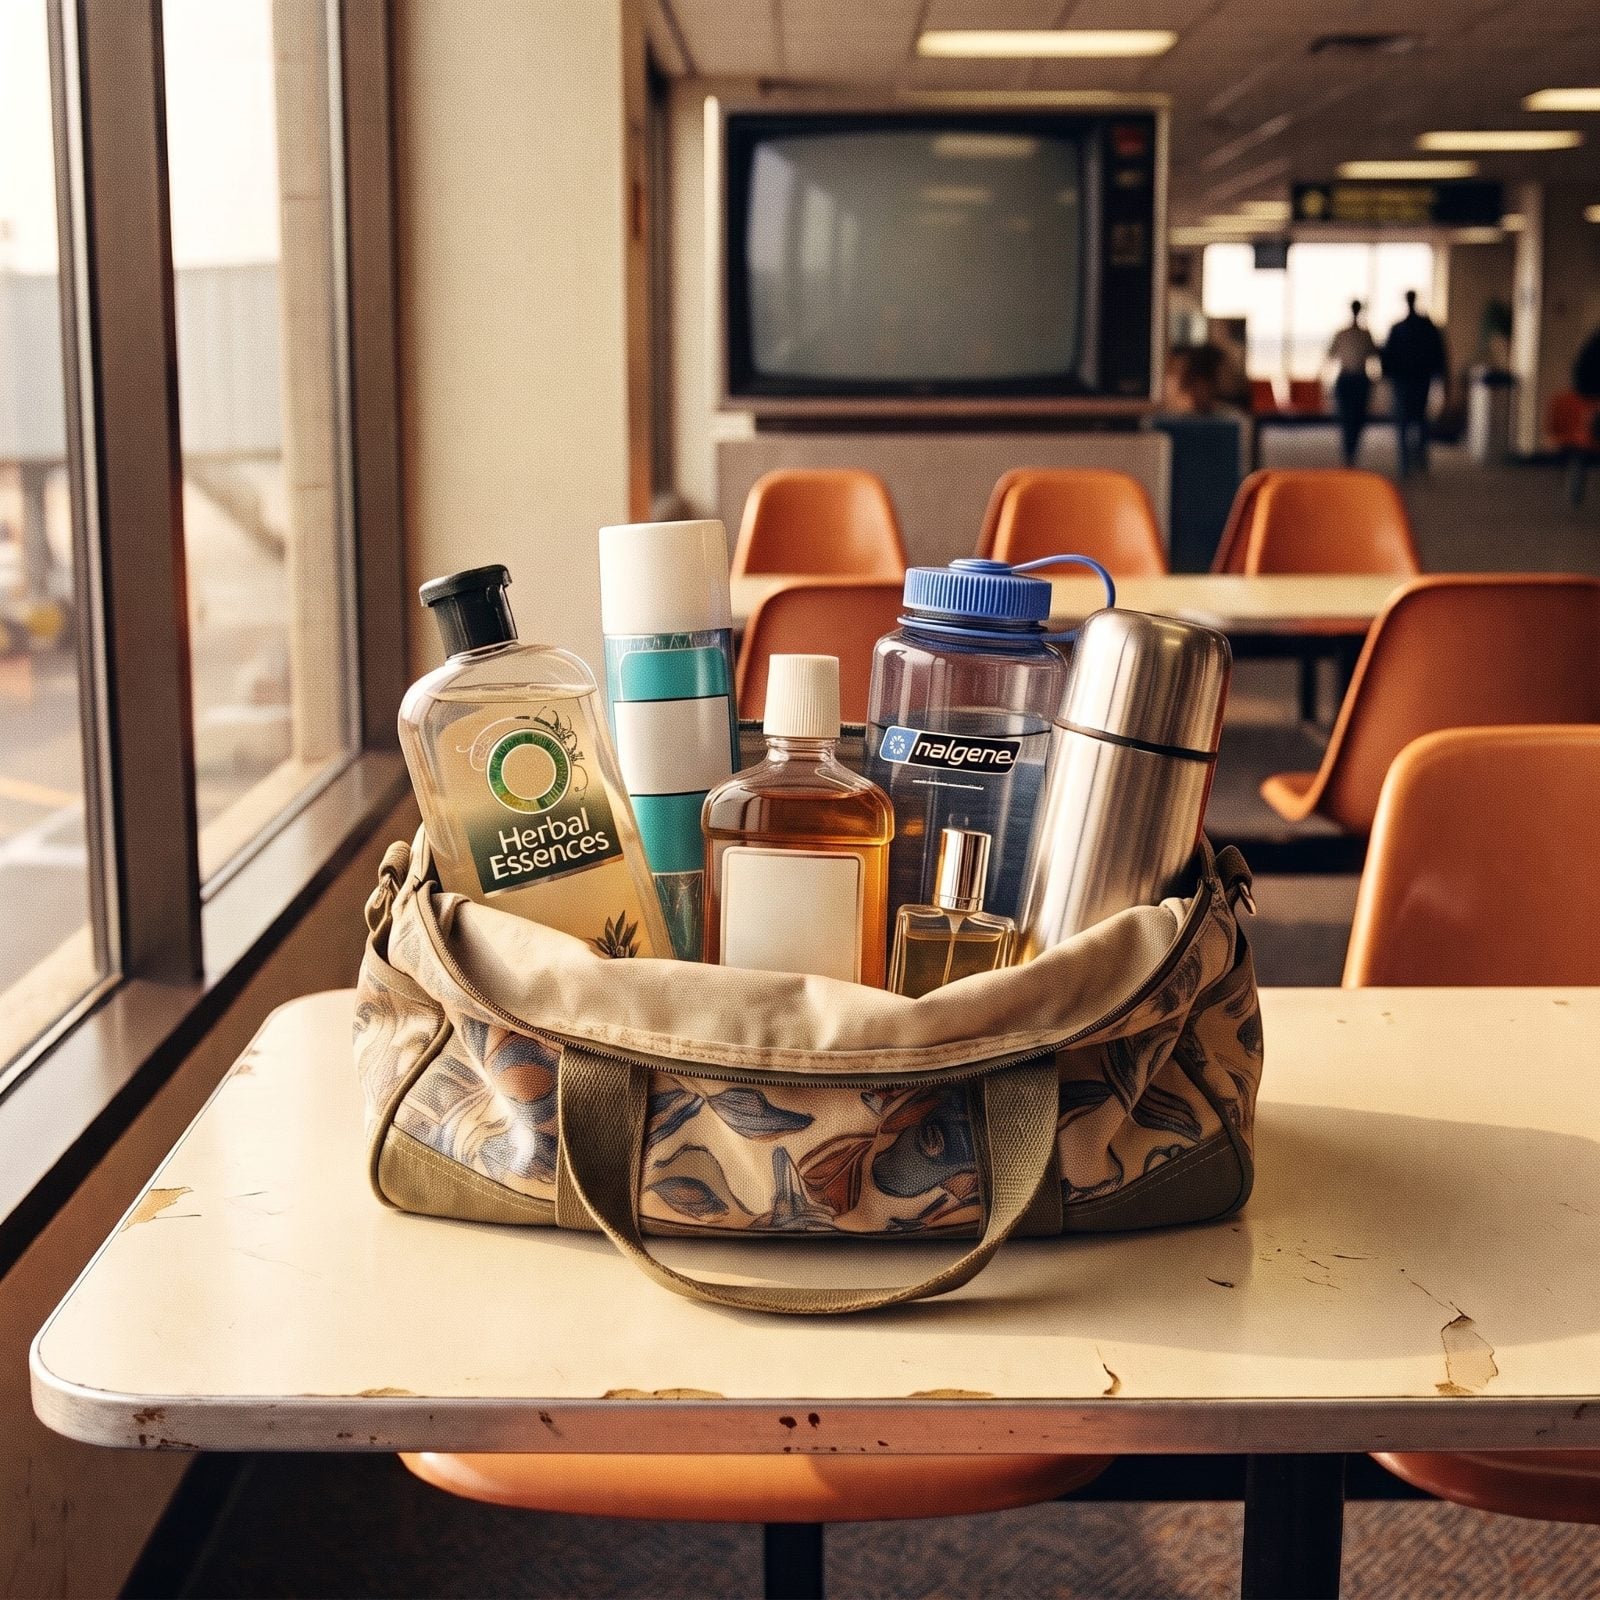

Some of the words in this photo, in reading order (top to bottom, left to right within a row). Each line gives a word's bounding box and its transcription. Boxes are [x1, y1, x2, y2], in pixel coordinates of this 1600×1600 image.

[915, 739, 1014, 766] nalgene
[498, 806, 591, 854] Herbal
[488, 831, 610, 881] Essences
